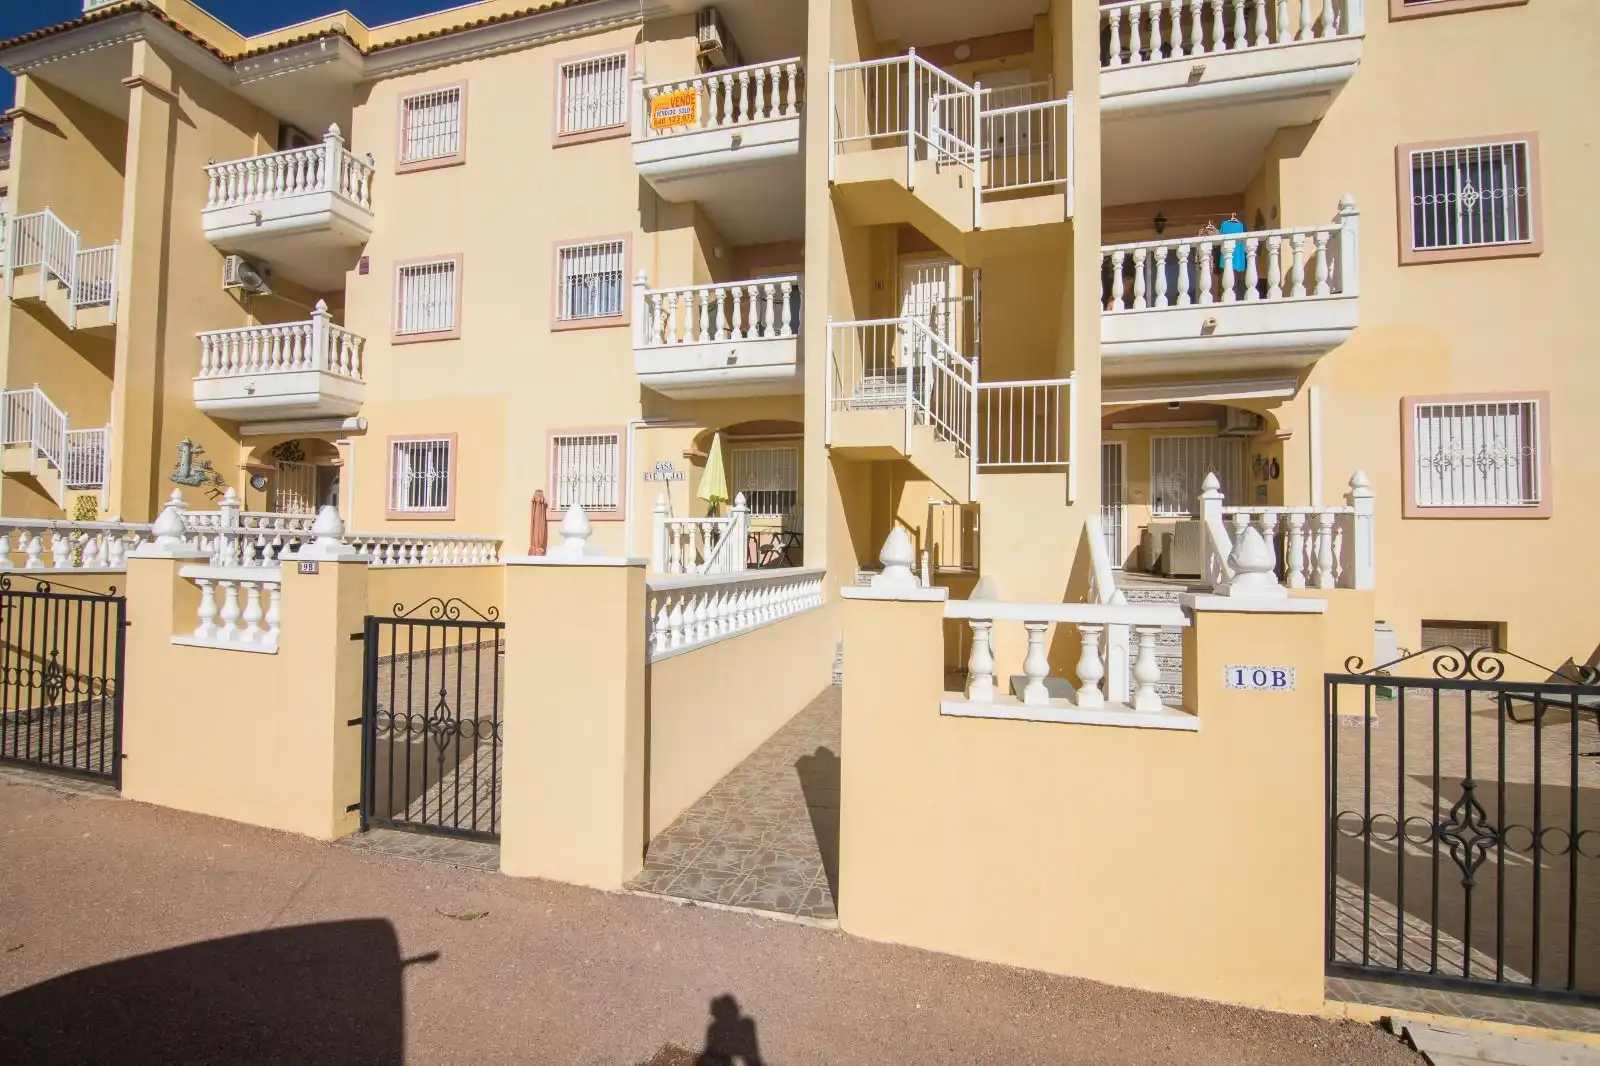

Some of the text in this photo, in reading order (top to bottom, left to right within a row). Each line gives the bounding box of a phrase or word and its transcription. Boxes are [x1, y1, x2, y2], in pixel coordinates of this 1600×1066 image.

[671, 94, 695, 107] VENDE
[303, 563, 314, 571] 9B
[1235, 669, 1287, 687] 10B
